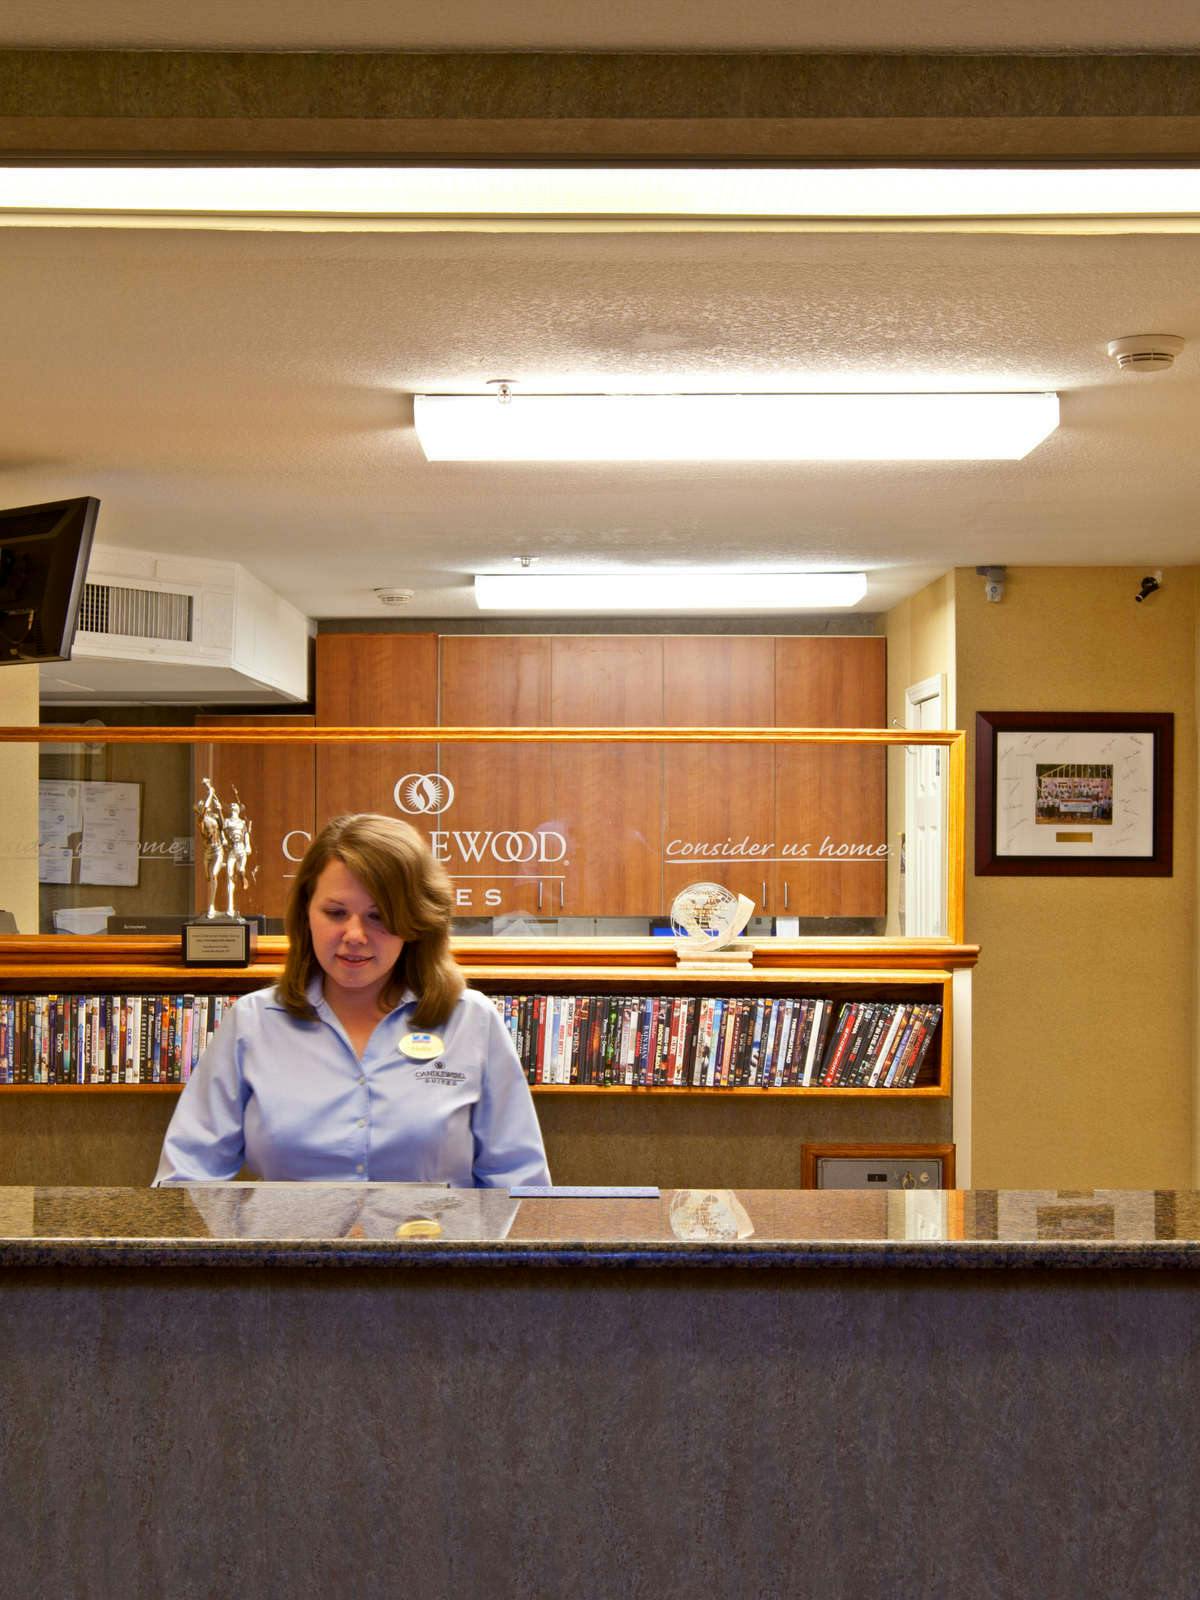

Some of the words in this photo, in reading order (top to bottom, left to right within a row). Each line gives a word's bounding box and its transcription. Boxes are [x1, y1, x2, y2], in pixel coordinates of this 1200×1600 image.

[282, 830, 567, 863] CEWOOD
[665, 836, 775, 857] Consider
[781, 842, 809, 857] us
